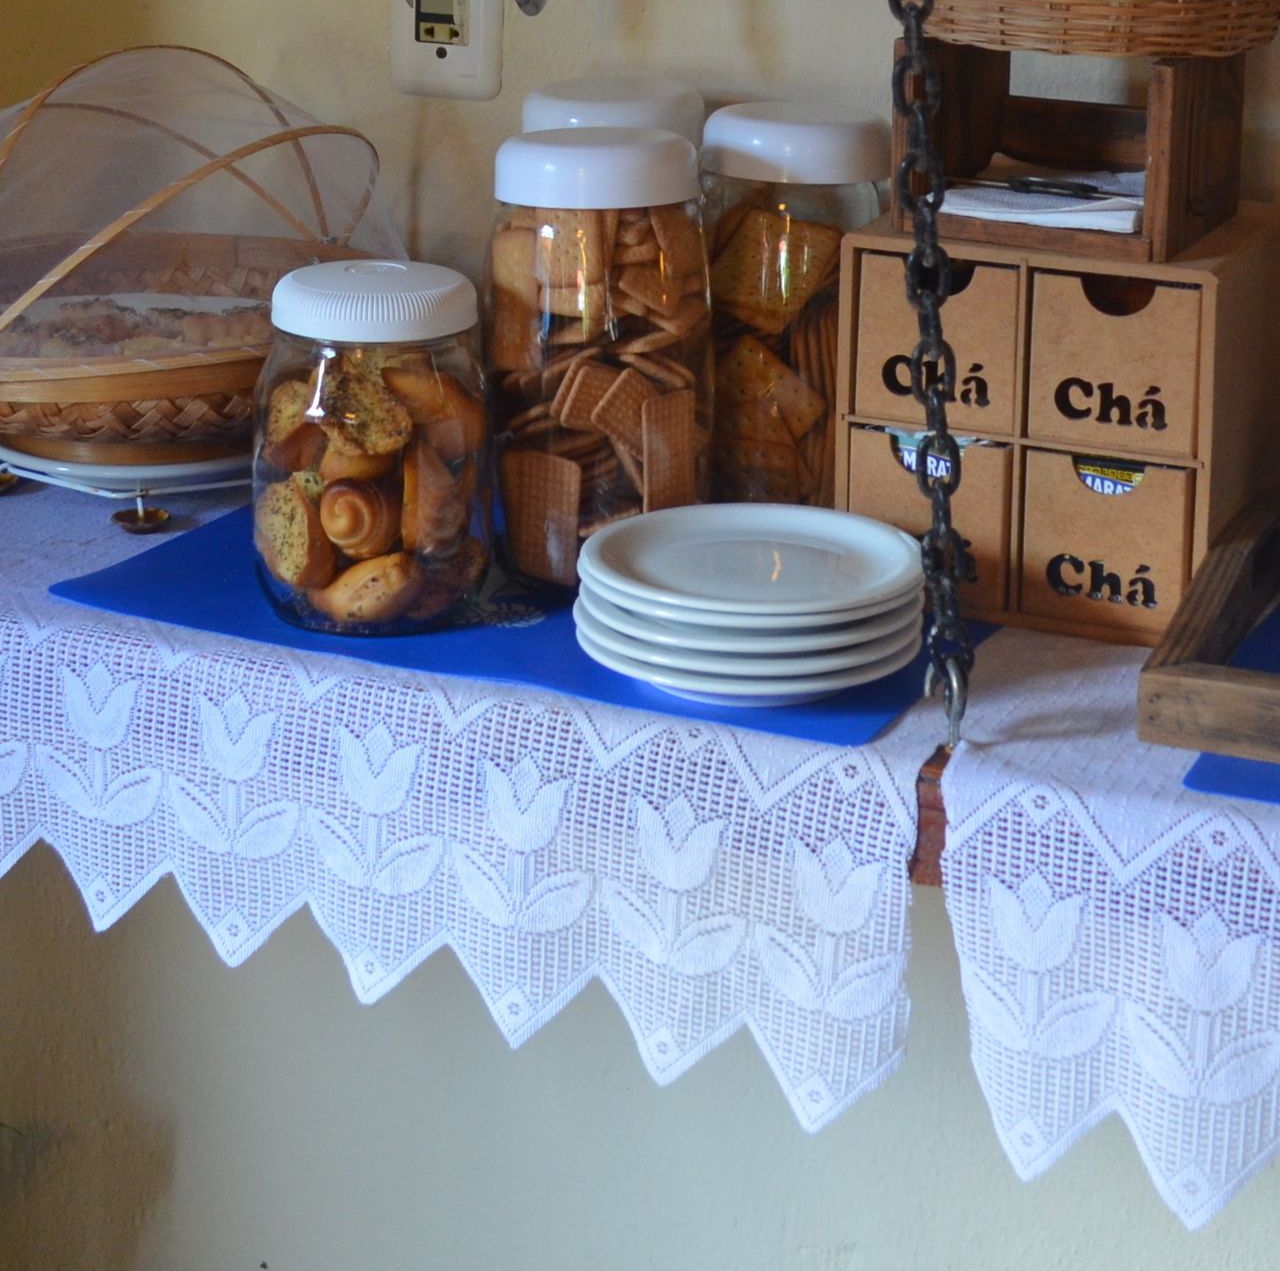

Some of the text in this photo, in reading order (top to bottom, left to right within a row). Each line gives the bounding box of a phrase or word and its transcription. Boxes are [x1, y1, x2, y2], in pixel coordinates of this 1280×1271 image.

[1054, 377, 1168, 431] Chá
[903, 450, 952, 478] MRA
[1046, 554, 1158, 609] Chá
